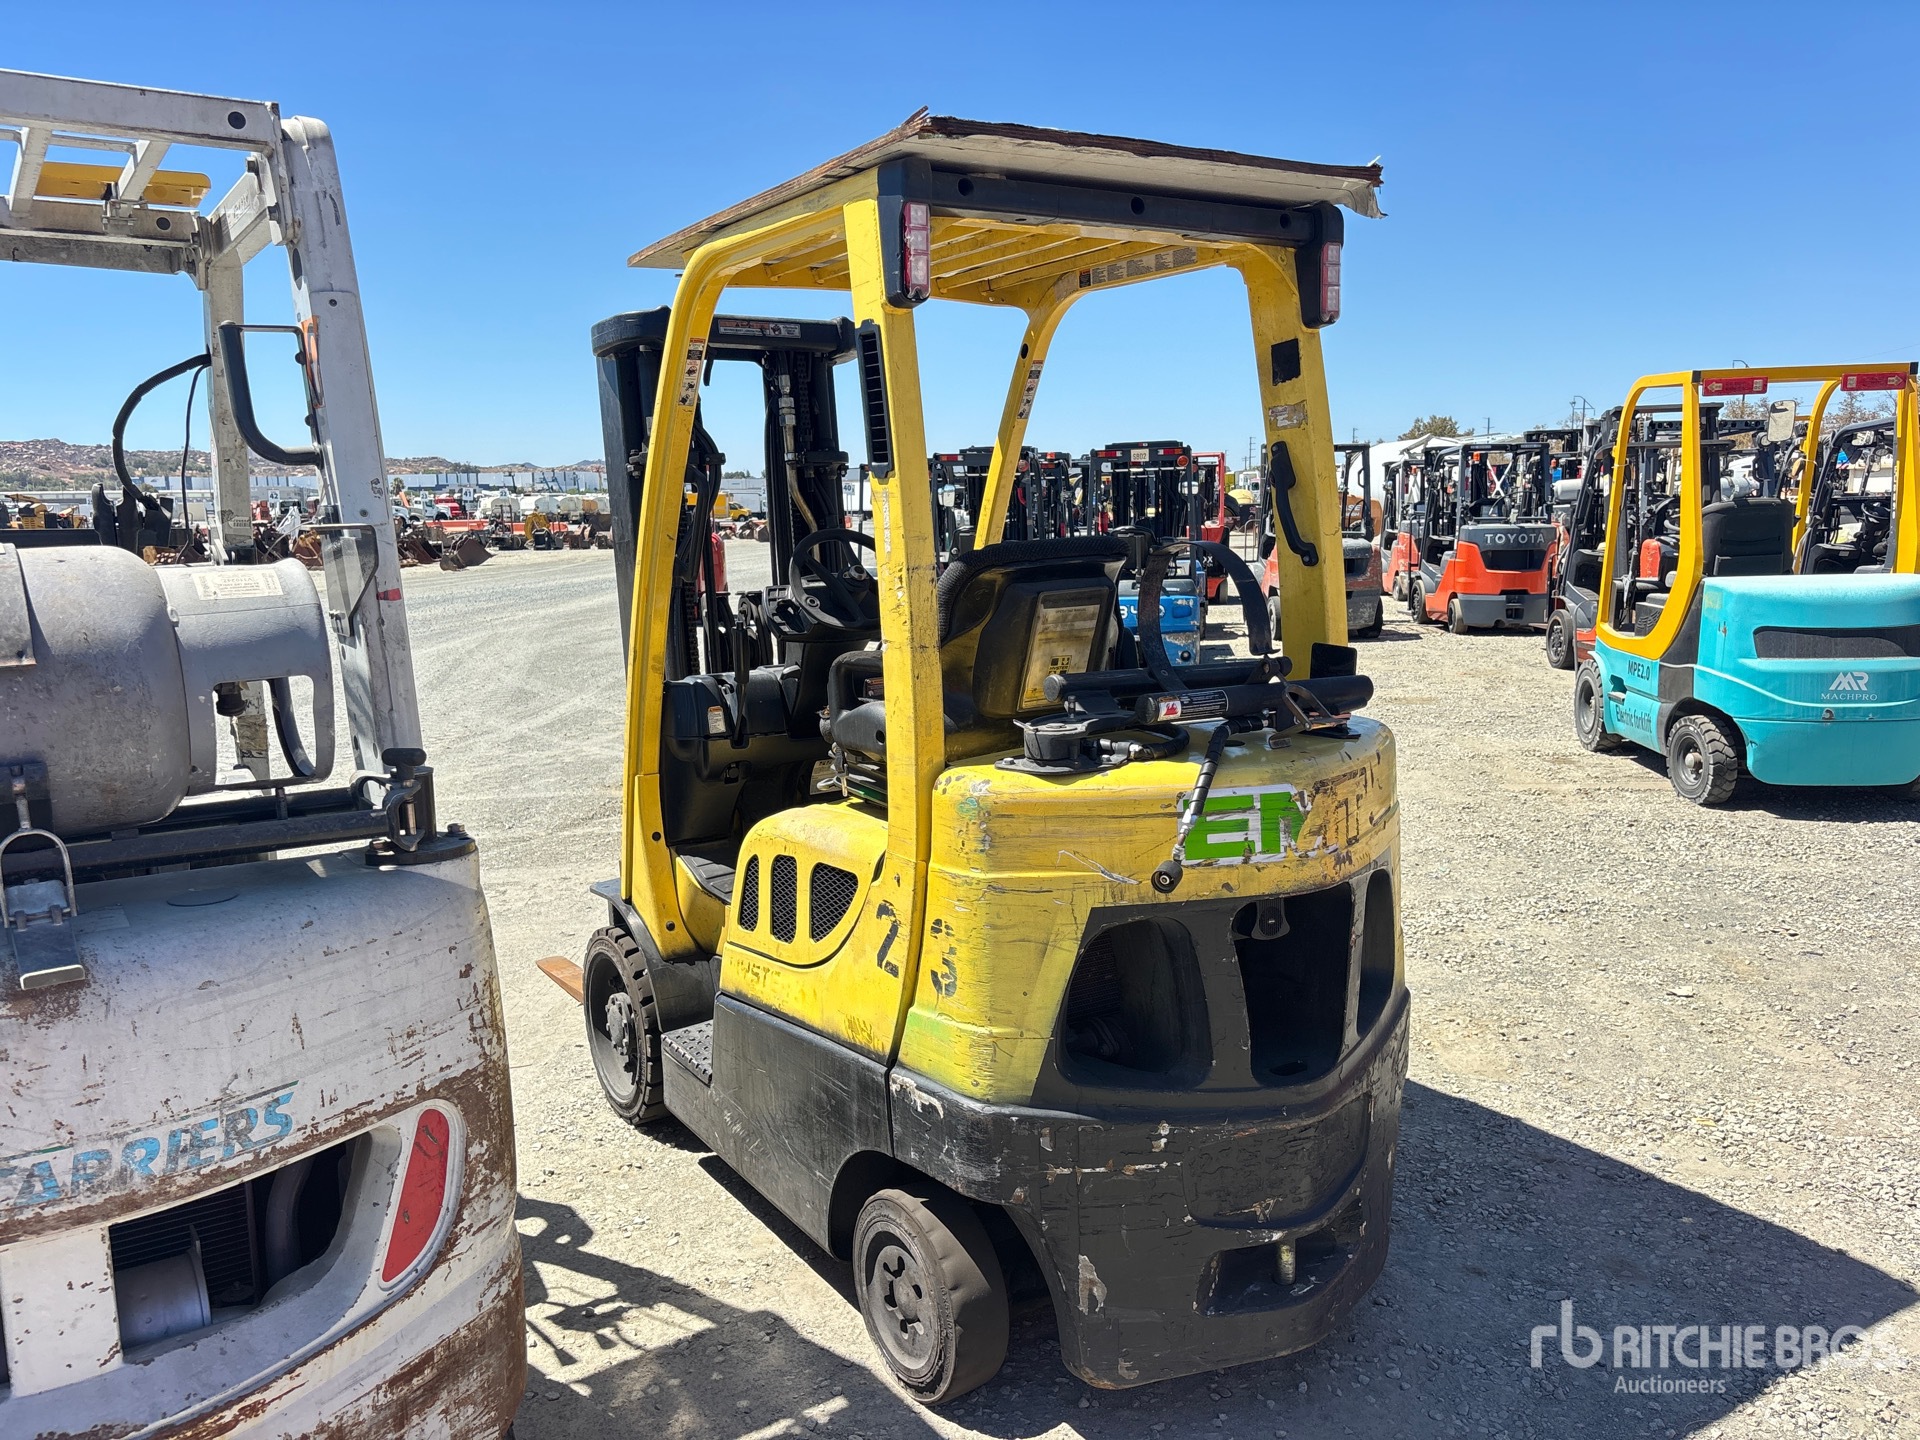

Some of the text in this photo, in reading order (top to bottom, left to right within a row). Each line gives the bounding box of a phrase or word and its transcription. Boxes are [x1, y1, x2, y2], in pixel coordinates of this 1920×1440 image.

[1484, 533, 1545, 544] TOYOTA
[1628, 660, 1650, 681] MPE2.0
[0, 1092, 294, 1206] ARRIERS
